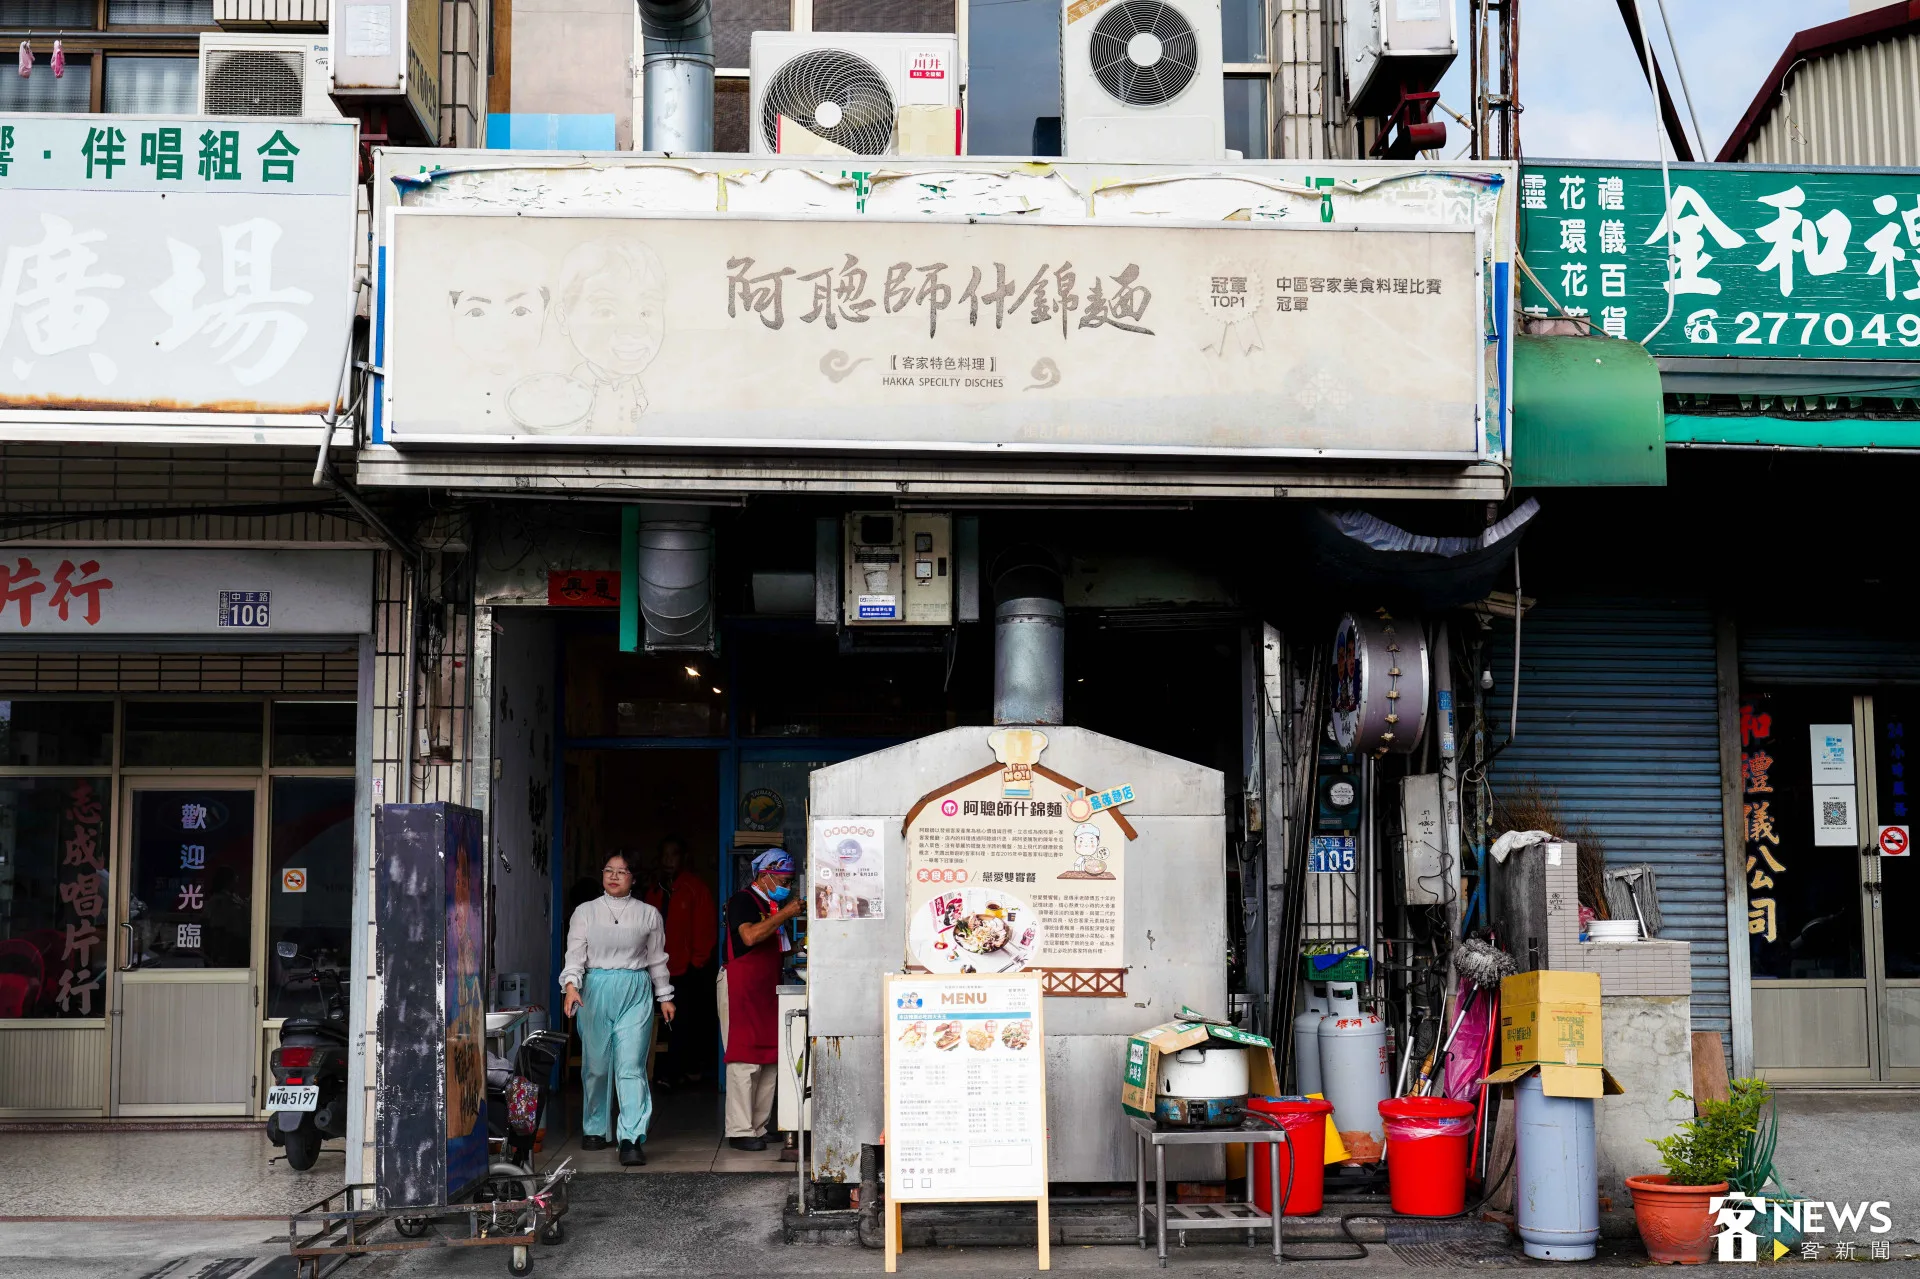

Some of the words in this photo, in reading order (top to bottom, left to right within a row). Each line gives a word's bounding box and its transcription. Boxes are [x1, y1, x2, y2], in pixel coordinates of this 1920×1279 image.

[913, 58, 942, 69] 川井
[1597, 175, 1628, 340] 禮儀百貨
[1211, 276, 1248, 294] 冠軍
[1276, 276, 1442, 295] 中區客家美食料理比賽
[0, 212, 315, 387] 廣場
[1211, 295, 1245, 308] TOP1
[1276, 296, 1309, 312] 冠軍
[882, 377, 915, 386] HAKKA
[919, 377, 961, 387] SPECILTY
[964, 378, 1004, 388] DISCHES
[0, 557, 114, 628] 片行
[231, 592, 268, 602] 中正路
[230, 604, 268, 625] 106
[963, 800, 1063, 818] 阿聰師什錦麵
[1317, 850, 1354, 871] 105
[177, 803, 208, 949] 歡迎光臨
[917, 869, 968, 882] 美食推薦
[56, 779, 105, 1015] 志成唱片行
[941, 992, 988, 1005] MENU
[268, 1092, 317, 1105] MVQ-5197
